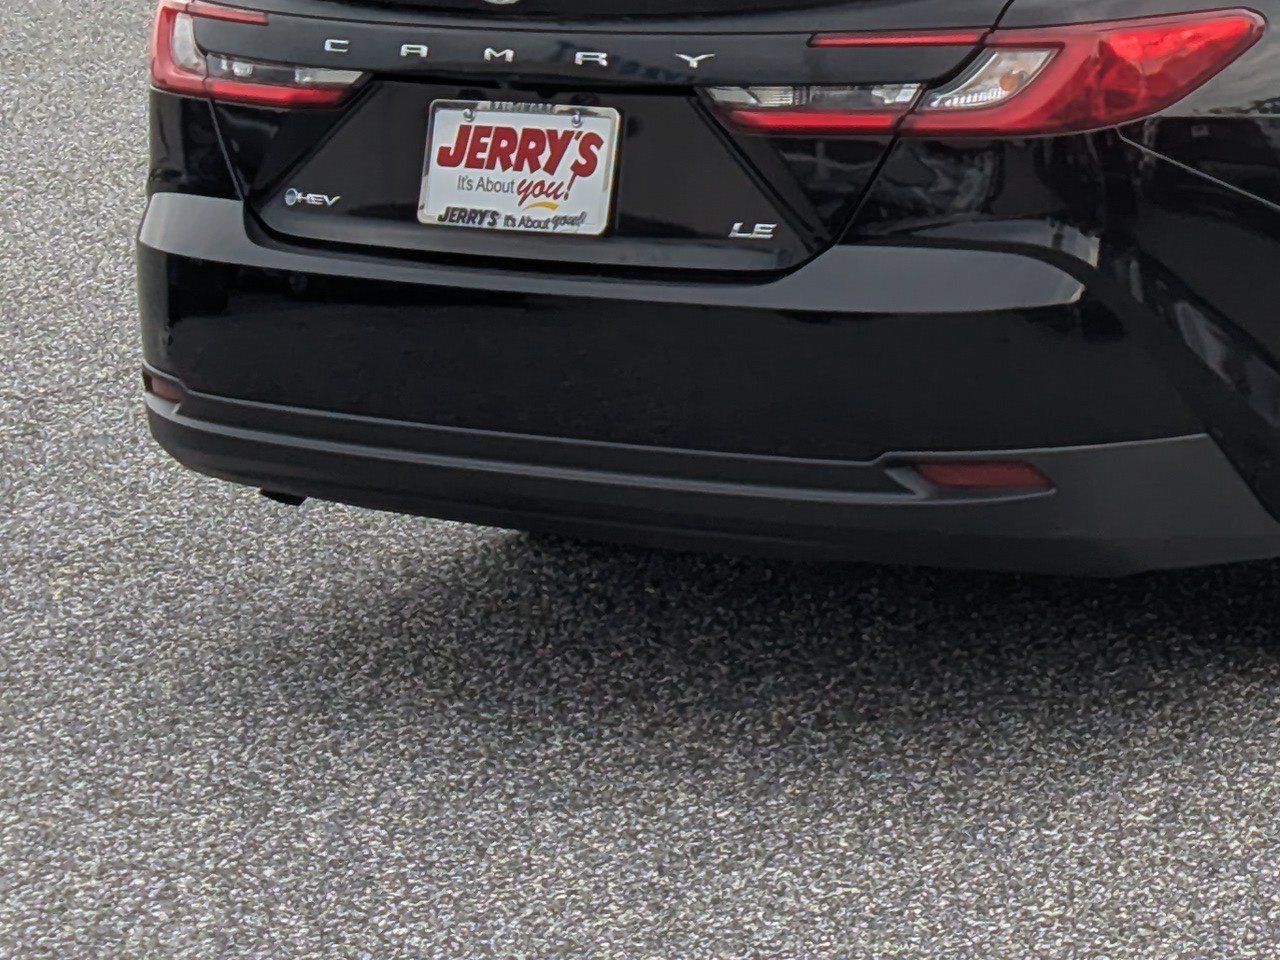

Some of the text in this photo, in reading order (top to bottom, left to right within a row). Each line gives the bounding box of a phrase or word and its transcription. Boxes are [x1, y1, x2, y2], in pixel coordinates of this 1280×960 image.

[324, 39, 716, 68] CAMRY
[436, 124, 604, 178] JERRY'S
[457, 172, 576, 207] It's About you!
[437, 206, 500, 227] JERRY'S
[517, 215, 549, 230] About
[728, 222, 777, 238] LE
